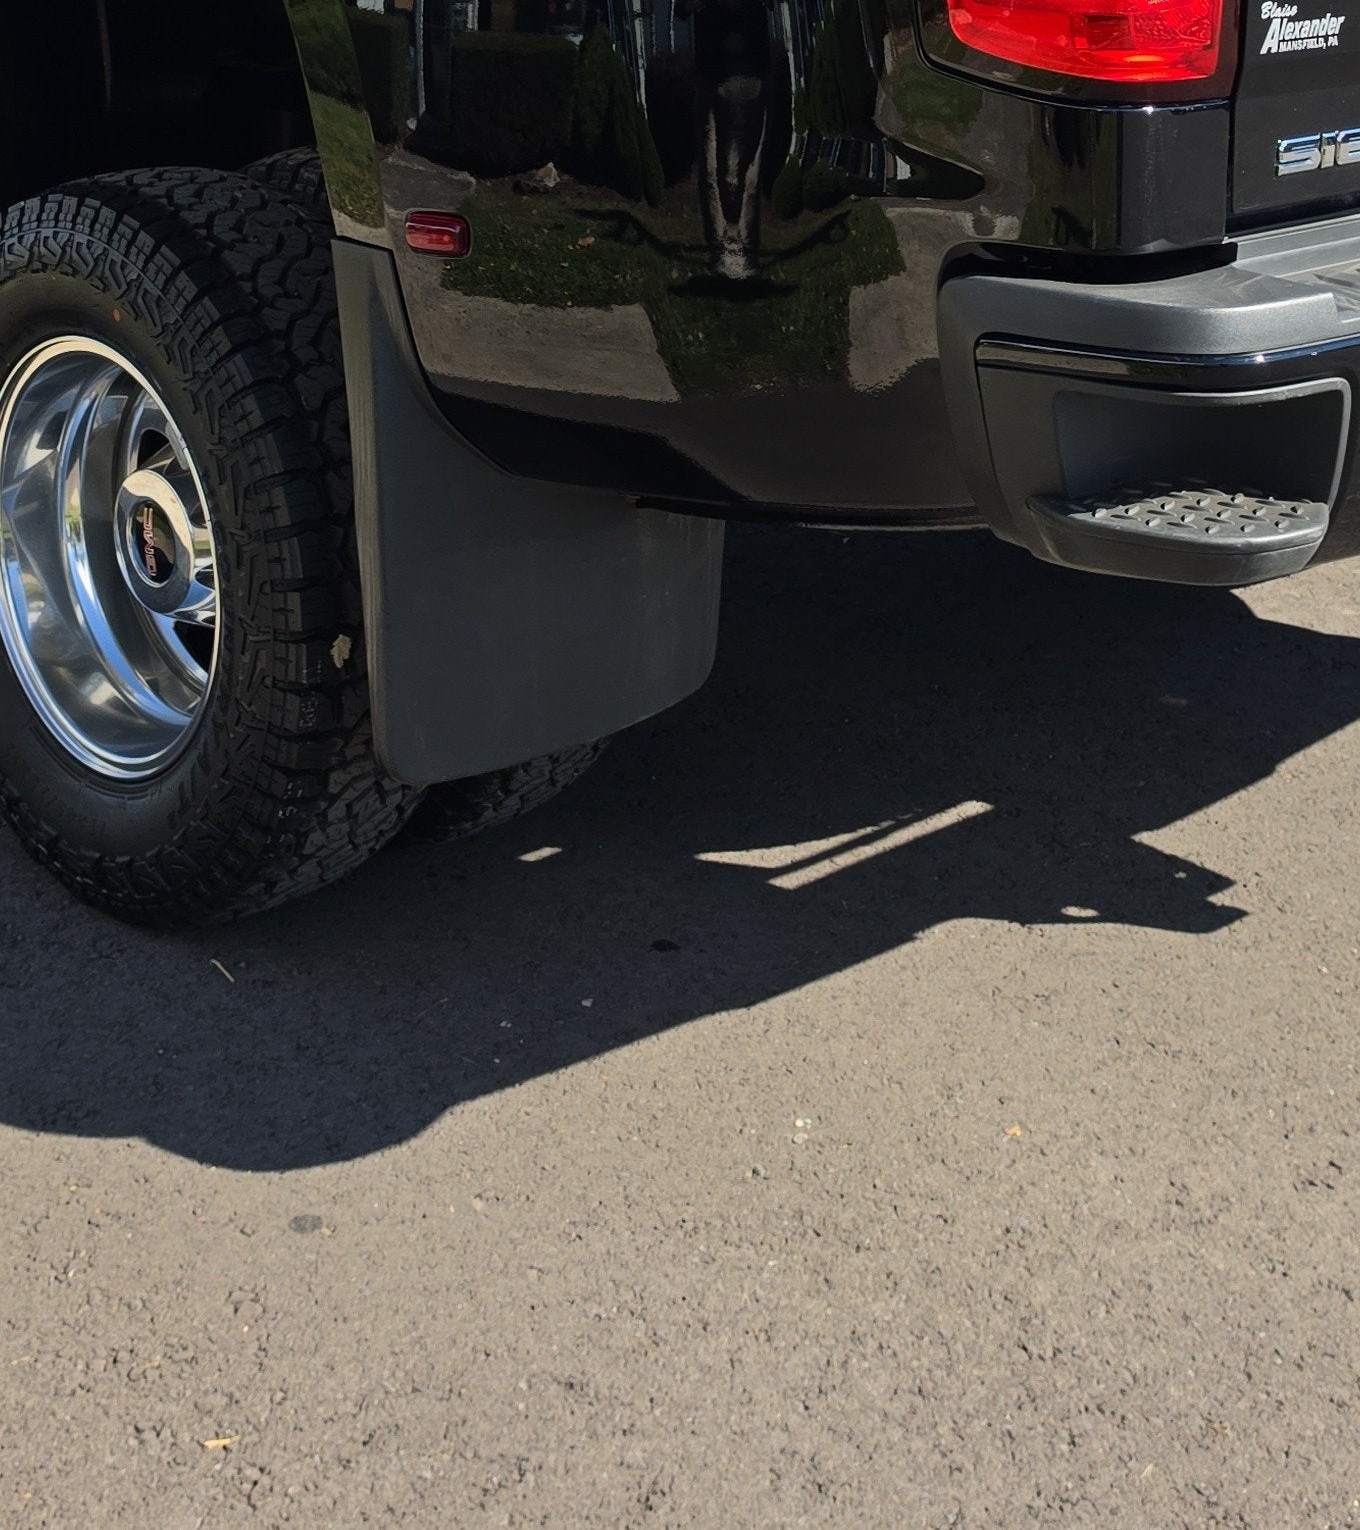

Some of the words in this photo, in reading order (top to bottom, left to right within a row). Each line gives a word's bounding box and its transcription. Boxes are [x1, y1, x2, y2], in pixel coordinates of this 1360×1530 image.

[1261, 1, 1298, 20] Blaise
[1260, 13, 1346, 55] Alexander
[1279, 37, 1326, 53] MANSFIELD,
[1328, 35, 1339, 47] PA
[143, 507, 157, 577] GMC
